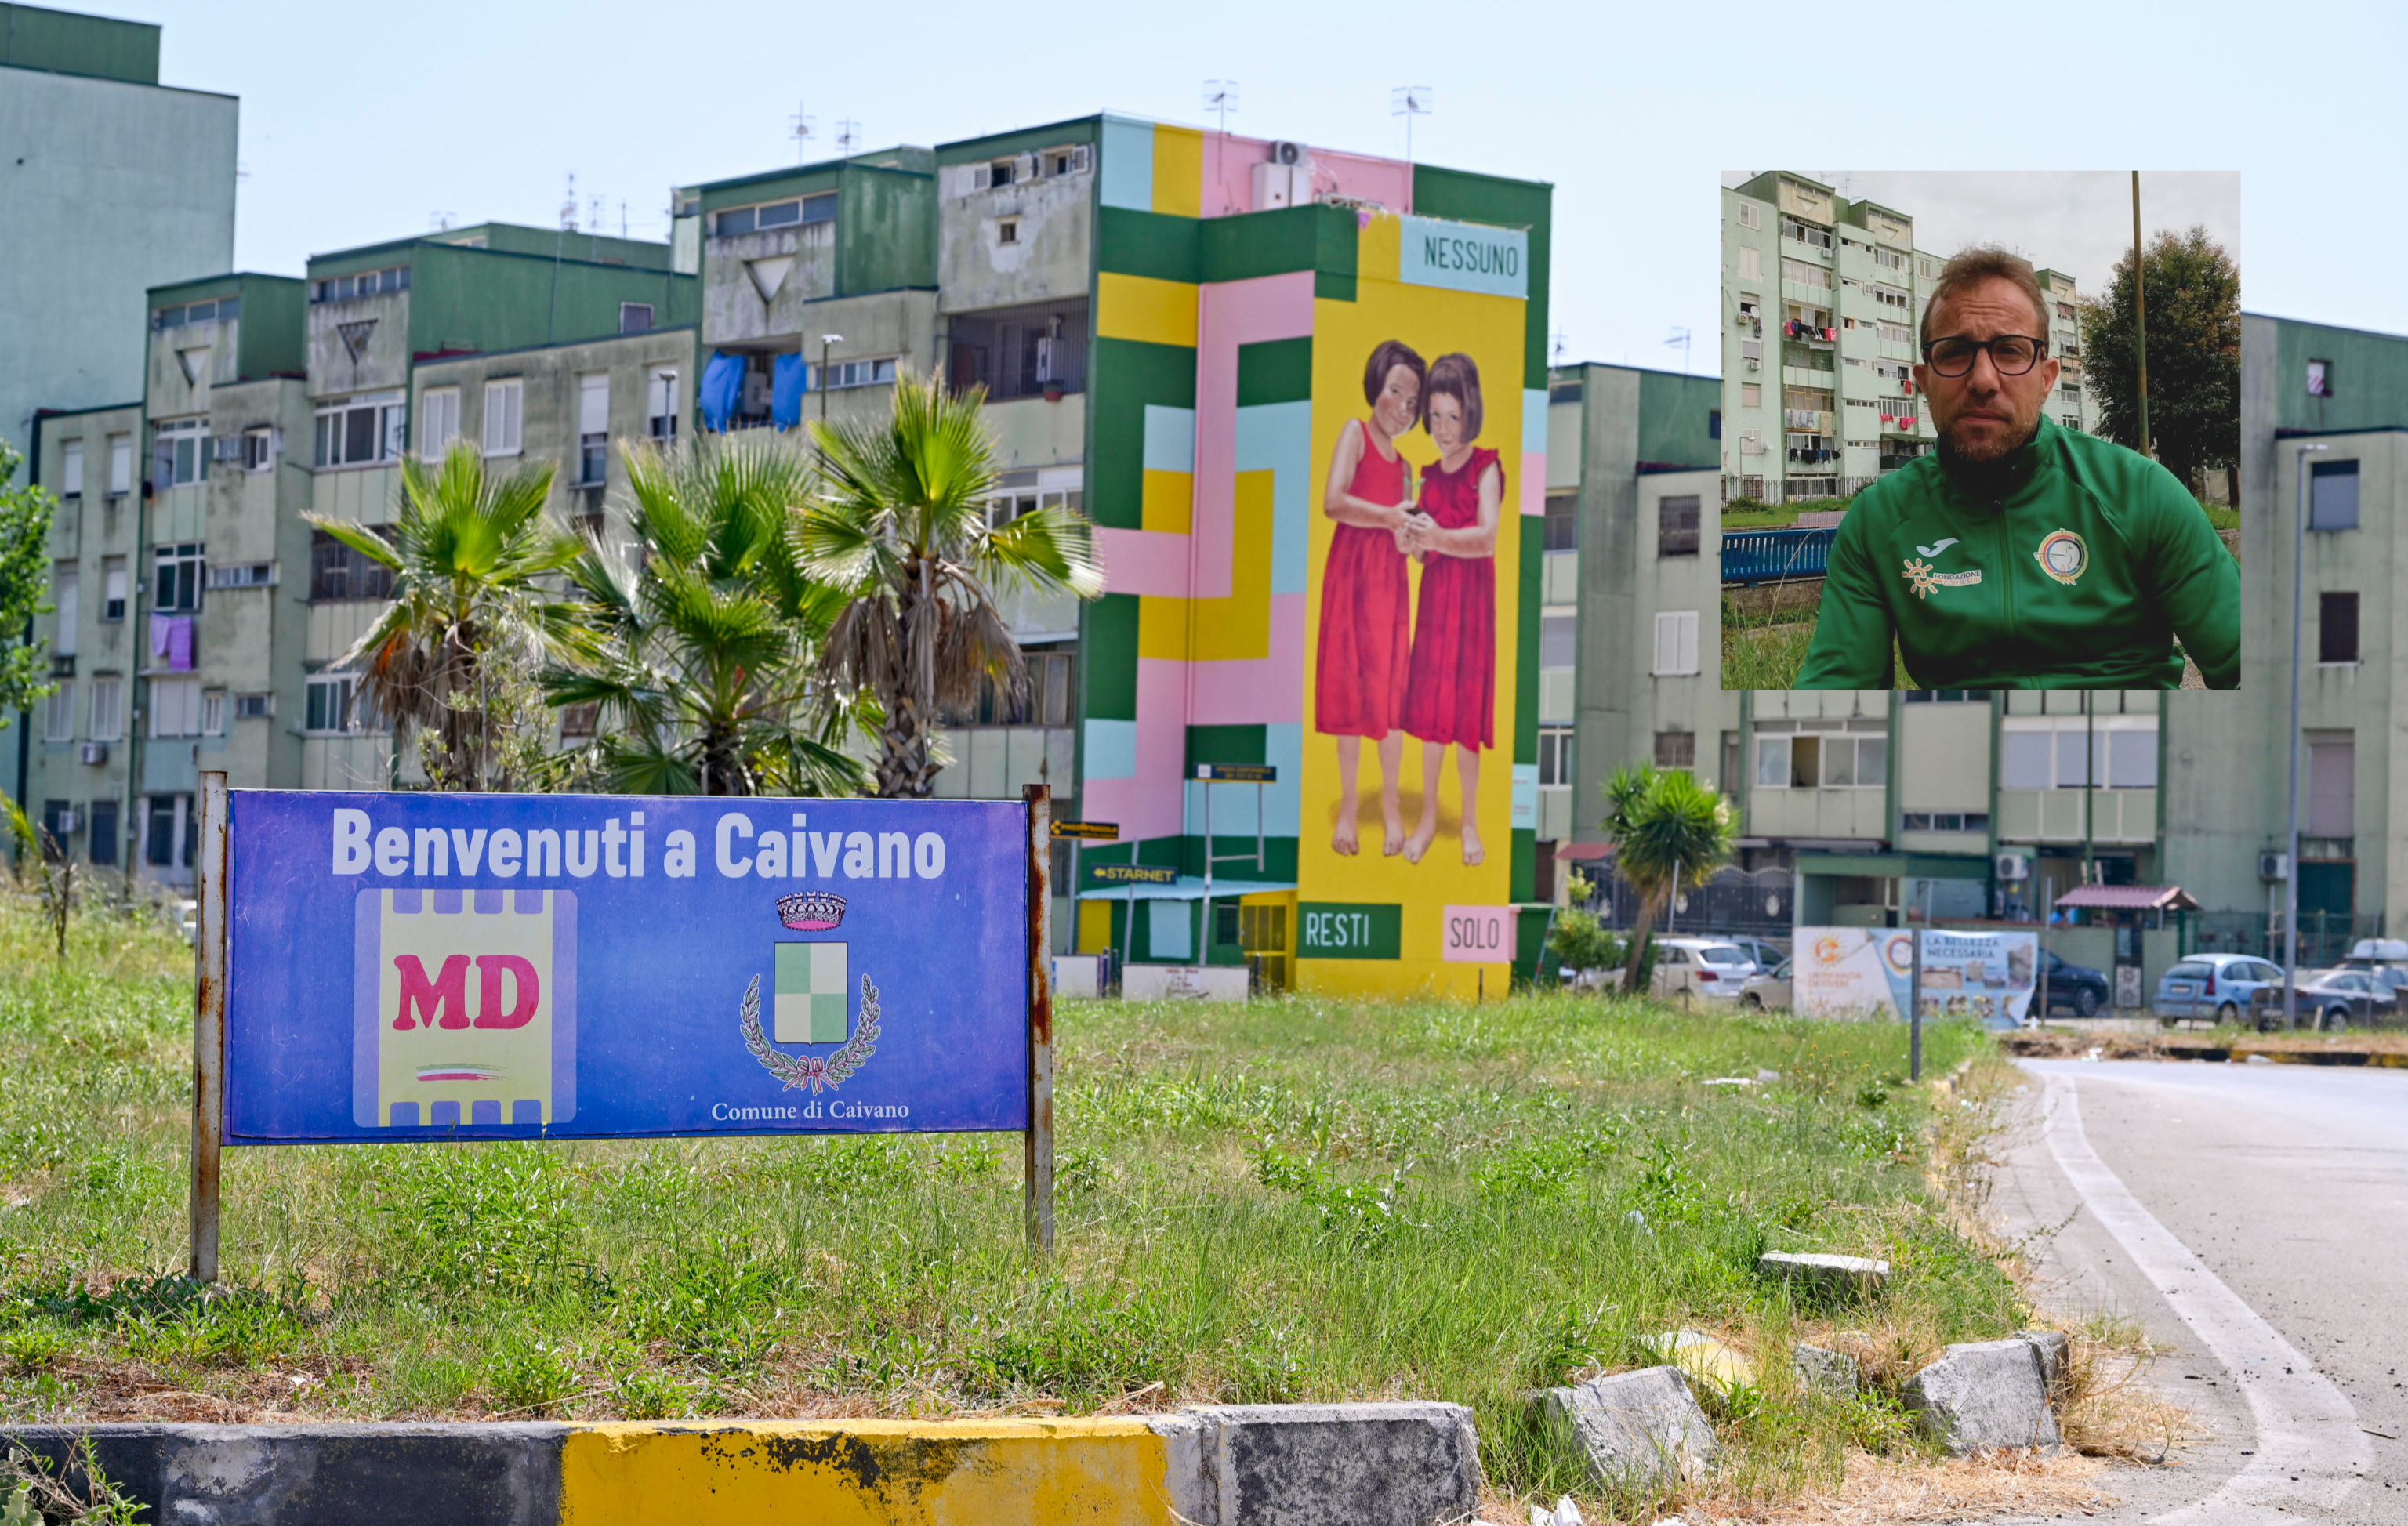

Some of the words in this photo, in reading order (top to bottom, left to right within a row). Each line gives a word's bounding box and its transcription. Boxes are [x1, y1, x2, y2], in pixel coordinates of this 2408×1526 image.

[1424, 234, 1518, 277] NESSUNO
[1934, 571, 1981, 581] FONDAZIONE
[332, 807, 645, 879] Benvenuti
[663, 828, 696, 879] a
[714, 812, 946, 880] Caivano
[1107, 867, 1174, 883] STARNET
[1305, 912, 1369, 947] RESTI
[1450, 916, 1500, 950] SOLO
[1926, 937, 1942, 946] LA
[1944, 937, 2000, 947] BELLEZZA
[1926, 948, 1995, 958] NECESSARIA
[392, 954, 540, 1031] MD
[711, 1102, 798, 1121] Comune
[803, 1100, 823, 1119] di
[829, 1100, 910, 1119] Caivano
